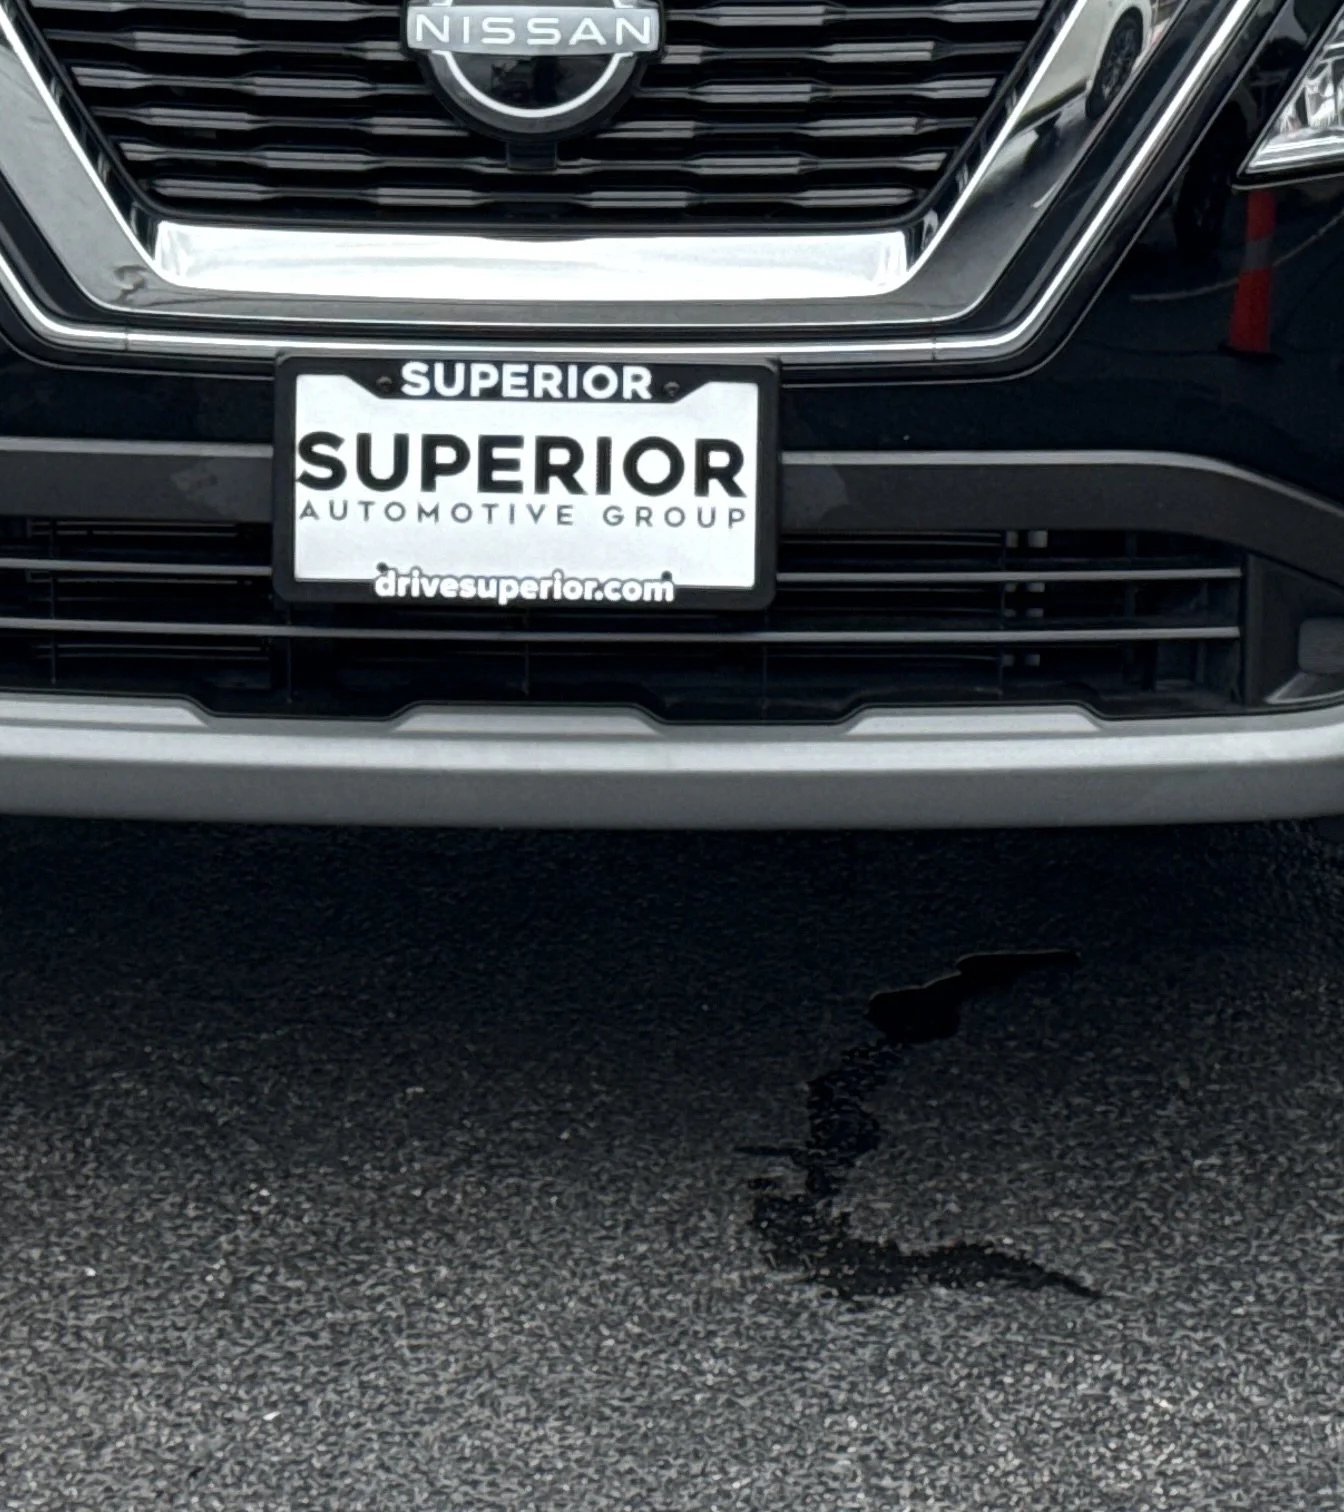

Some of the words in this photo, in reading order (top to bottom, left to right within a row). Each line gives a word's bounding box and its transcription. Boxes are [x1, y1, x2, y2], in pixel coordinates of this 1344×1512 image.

[415, 13, 652, 45] NISSAN
[400, 360, 653, 401] SUPERIOR
[295, 430, 748, 498] SUPERIOR
[297, 499, 576, 527] AUTOMOTIVE
[602, 505, 748, 530] GROUP
[374, 568, 675, 605] drivesuperior.com
